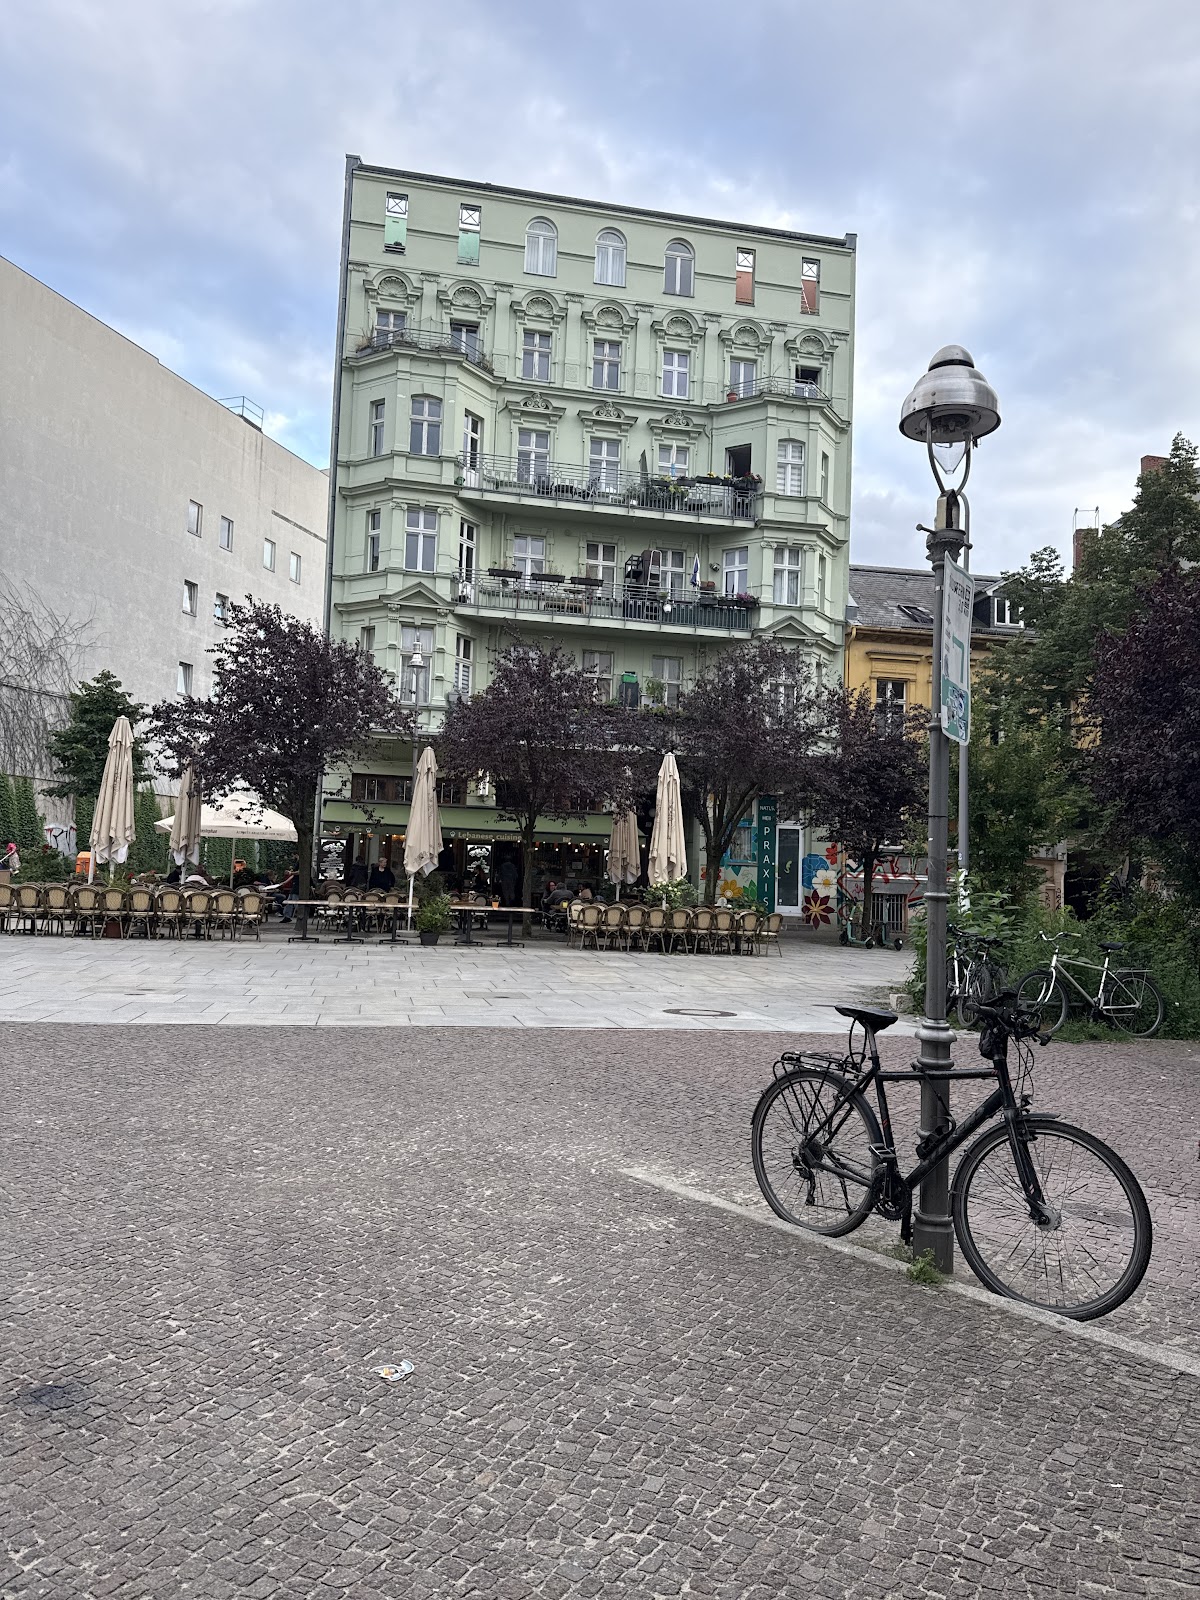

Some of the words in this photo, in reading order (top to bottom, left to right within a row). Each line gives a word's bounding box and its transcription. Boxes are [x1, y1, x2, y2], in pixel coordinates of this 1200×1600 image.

[458, 831, 493, 840] Lebanese
[496, 833, 522, 841] cuisine
[763, 826, 771, 907] PRAXIS
